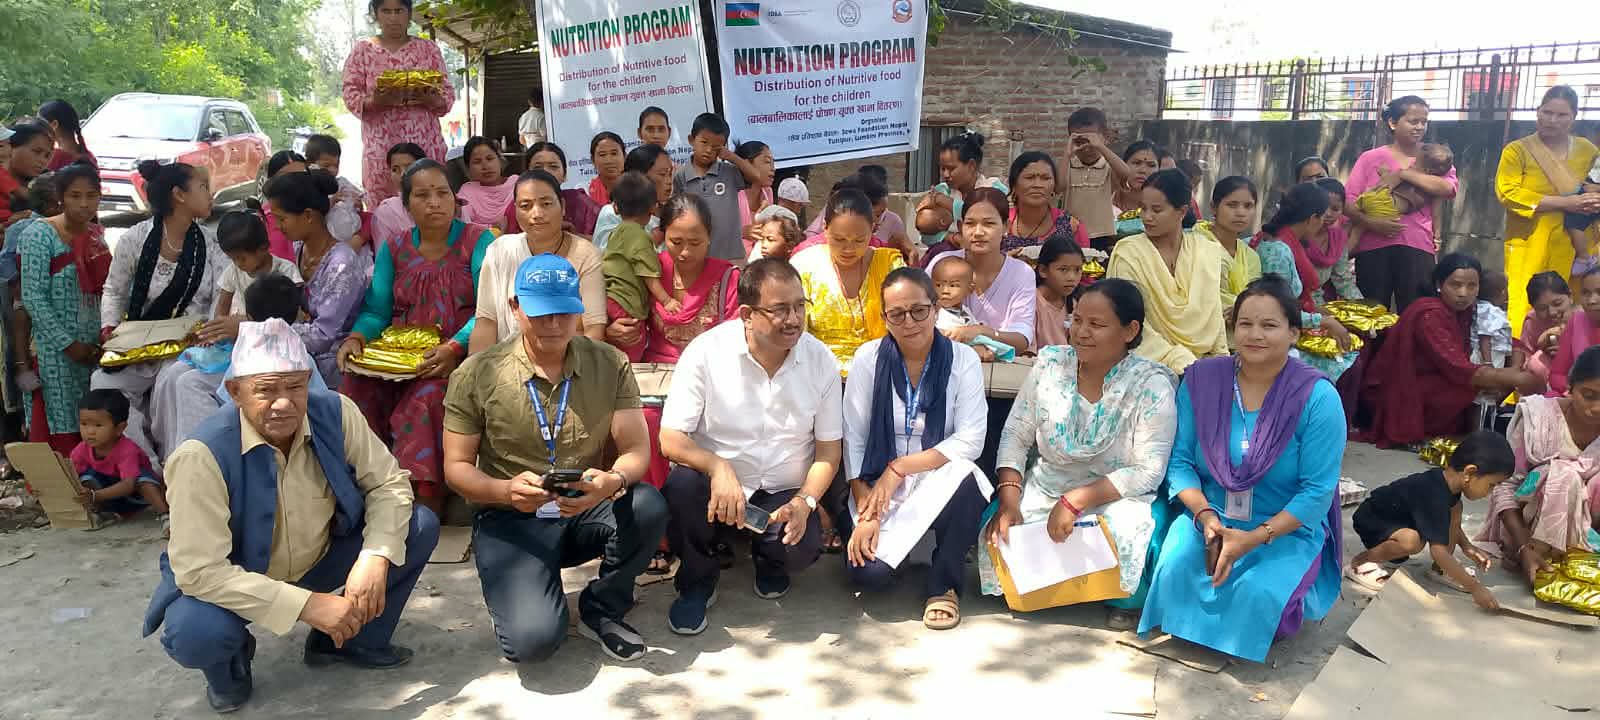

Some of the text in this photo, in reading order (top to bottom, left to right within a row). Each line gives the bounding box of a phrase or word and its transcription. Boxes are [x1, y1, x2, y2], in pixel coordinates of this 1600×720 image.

[551, 5, 692, 58] NUTRITION PROGRAM
[560, 53, 687, 82] Distribution of Nutritive food
[733, 37, 916, 76] NUTRITION PROGRAM
[588, 74, 657, 92] for the children
[754, 68, 902, 93] Distribution of Nutritive food
[794, 89, 871, 106] for the children
